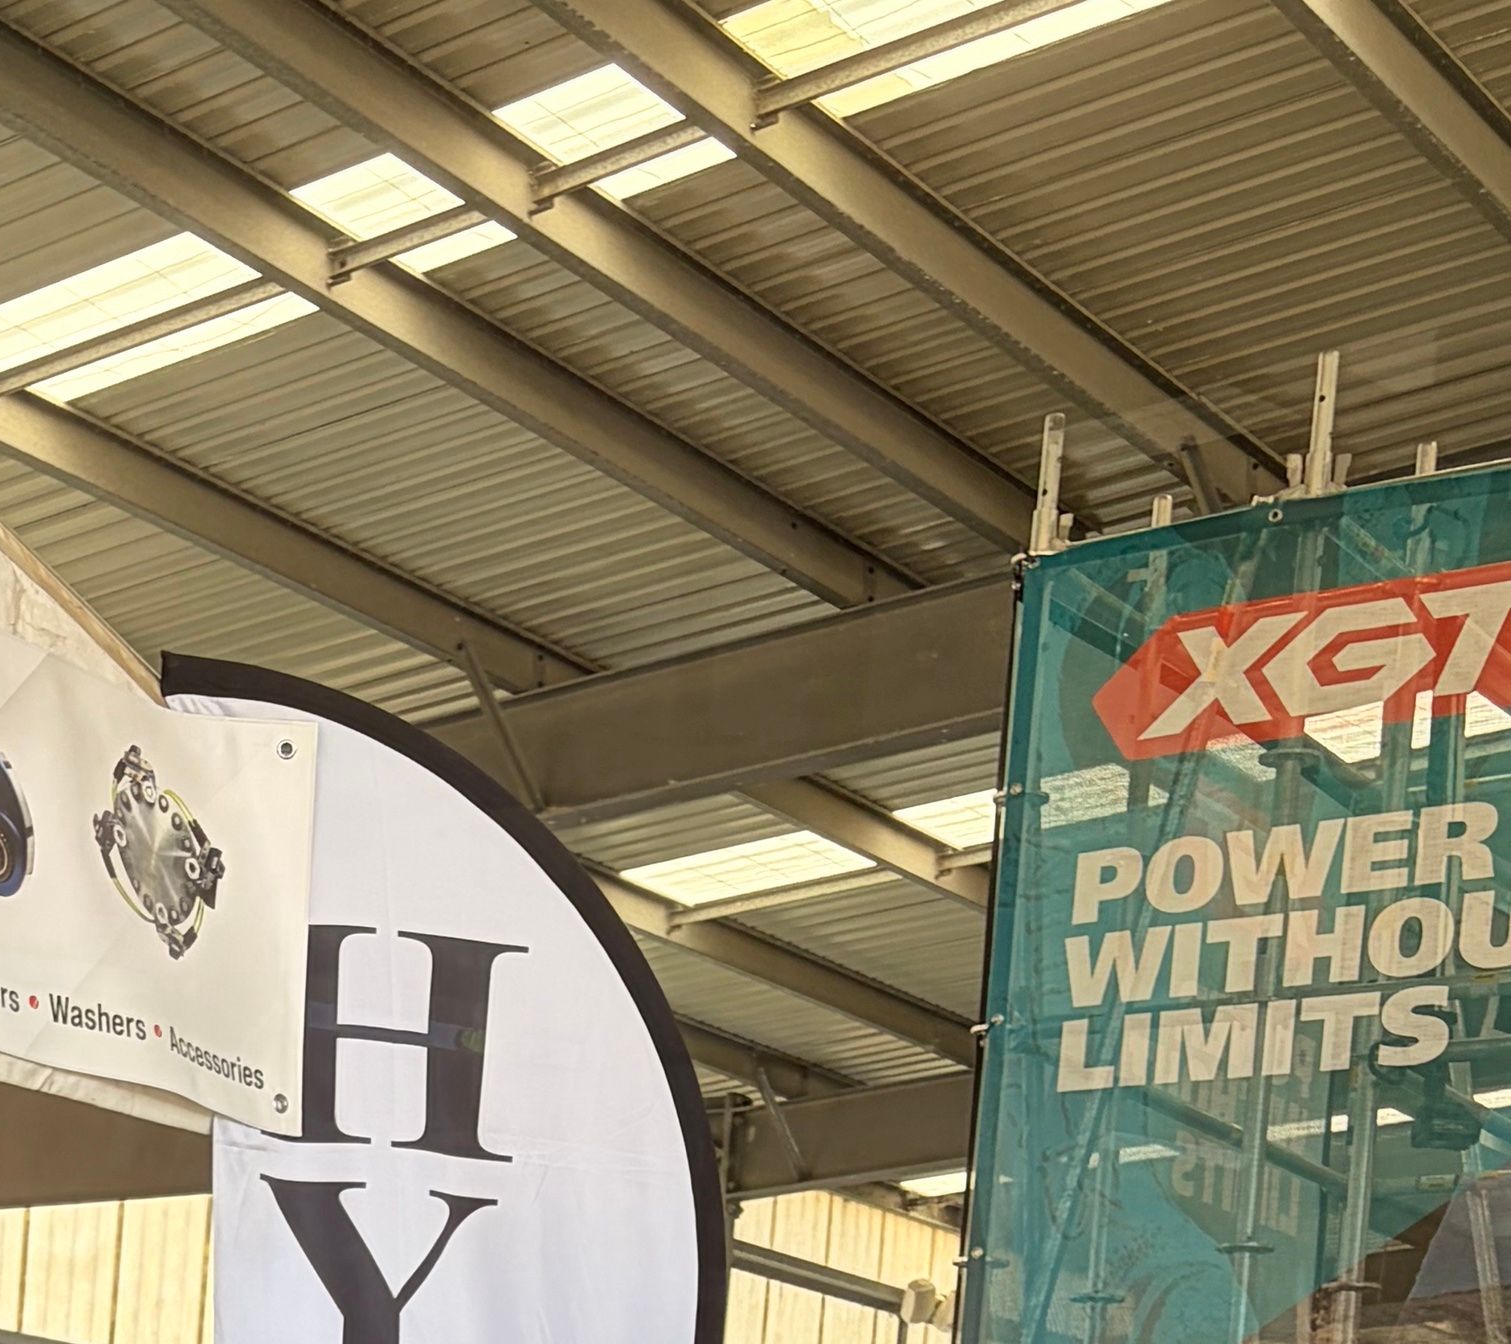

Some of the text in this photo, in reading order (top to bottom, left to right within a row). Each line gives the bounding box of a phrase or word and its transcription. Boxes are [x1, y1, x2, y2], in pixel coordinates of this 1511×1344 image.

[1070, 800, 1499, 926] POWER
[1064, 889, 1511, 1009] WITHOU
[48, 992, 148, 1041] Washers
[168, 1025, 265, 1090] Accessories
[1056, 985, 1451, 1093] LIMITS
